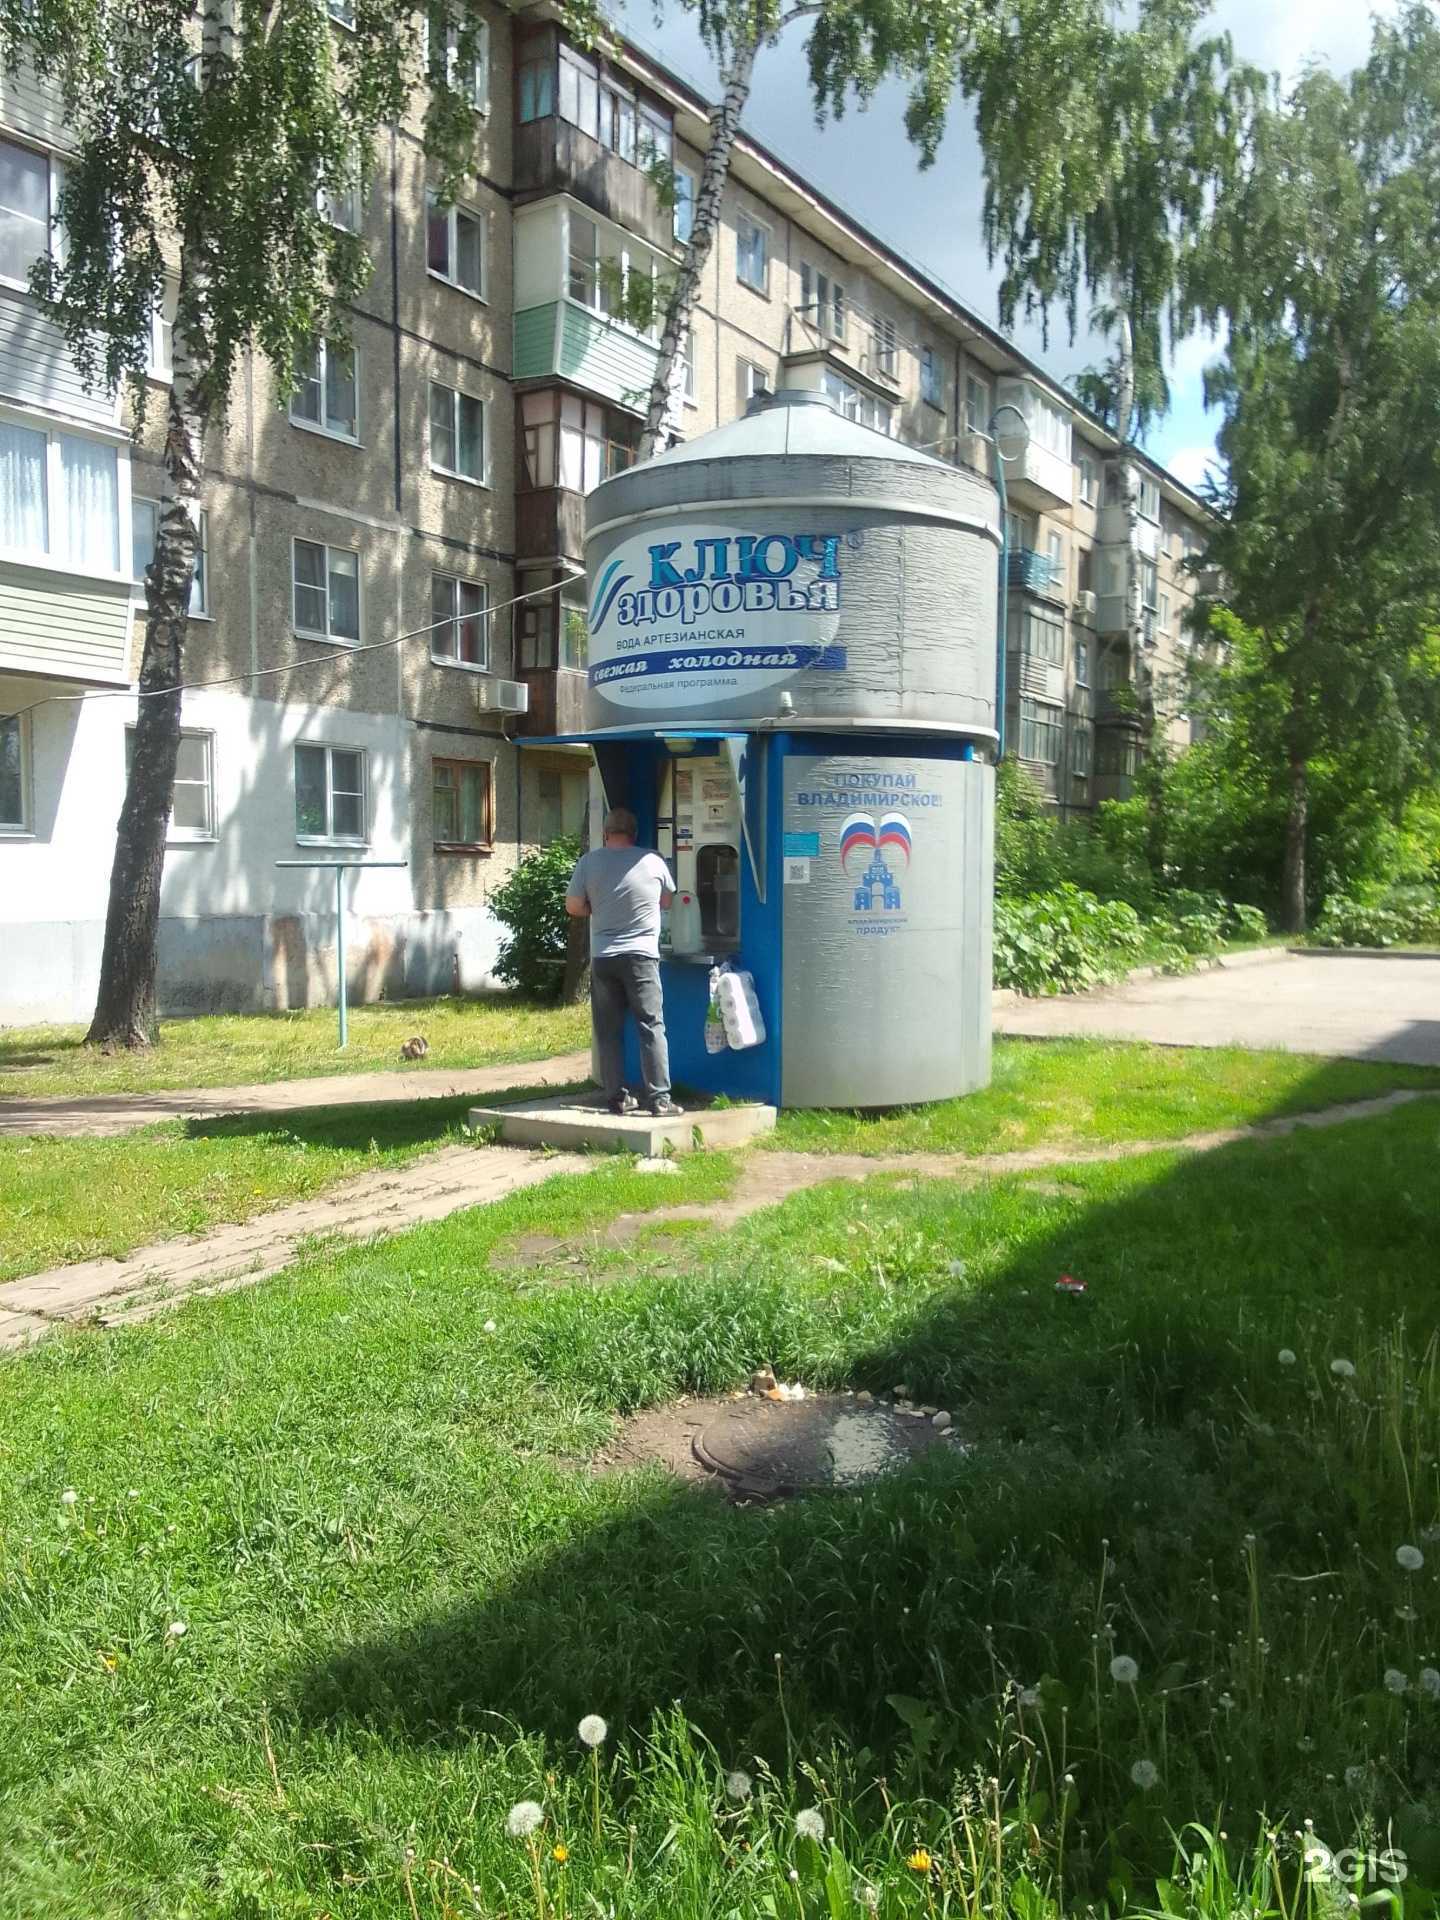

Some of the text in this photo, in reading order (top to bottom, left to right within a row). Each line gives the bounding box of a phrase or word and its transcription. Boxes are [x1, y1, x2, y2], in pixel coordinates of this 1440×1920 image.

[648, 534, 841, 590] КЛЮЧ
[616, 628, 745, 651] ВОДА АРТЕЗИАНСКАЯ
[667, 650, 799, 671] холодная
[676, 675, 738, 690] программа
[834, 773, 916, 787] ПОКУПАЙ
